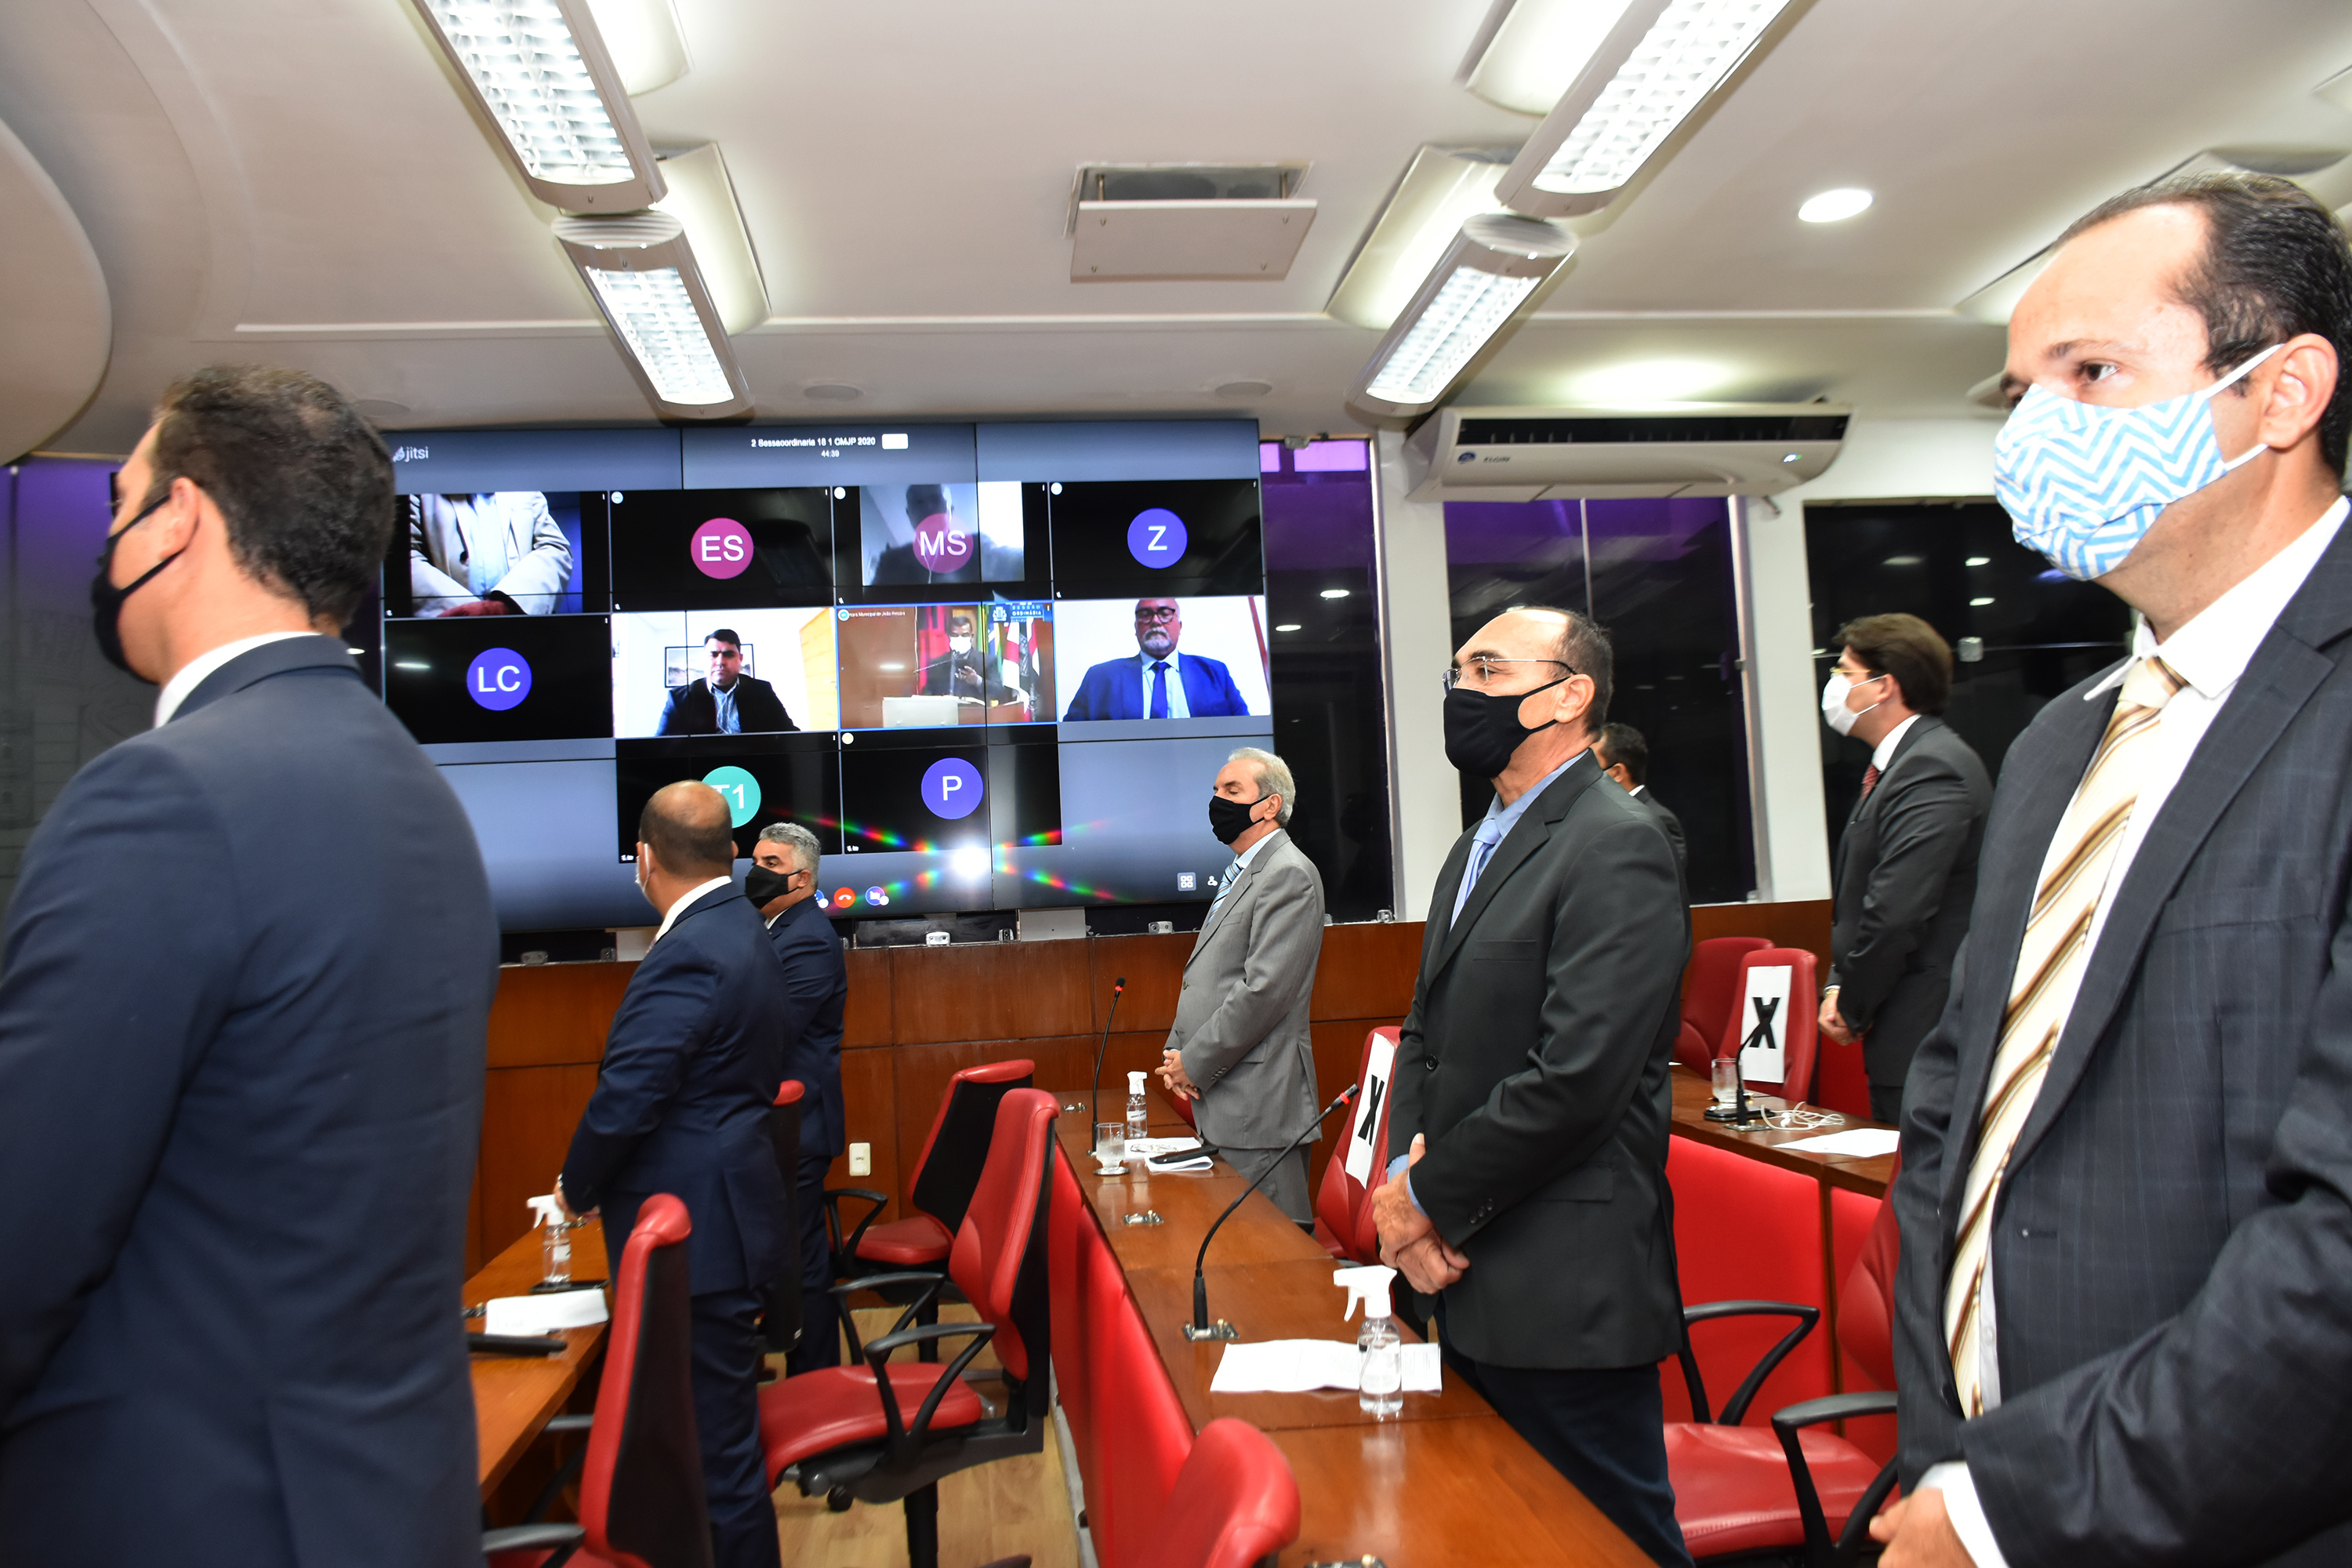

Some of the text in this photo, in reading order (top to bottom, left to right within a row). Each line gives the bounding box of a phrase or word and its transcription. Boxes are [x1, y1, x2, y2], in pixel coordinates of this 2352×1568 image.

[405, 445, 429, 463] jitsi
[751, 438, 757, 448] 2
[828, 437, 833, 446] 1
[834, 437, 857, 446] CMJP
[857, 436, 877, 446] 2020
[701, 534, 745, 562] ES
[920, 529, 967, 556] MS
[1148, 525, 1167, 551] Z
[477, 665, 521, 692] LC
[942, 775, 963, 801] P
